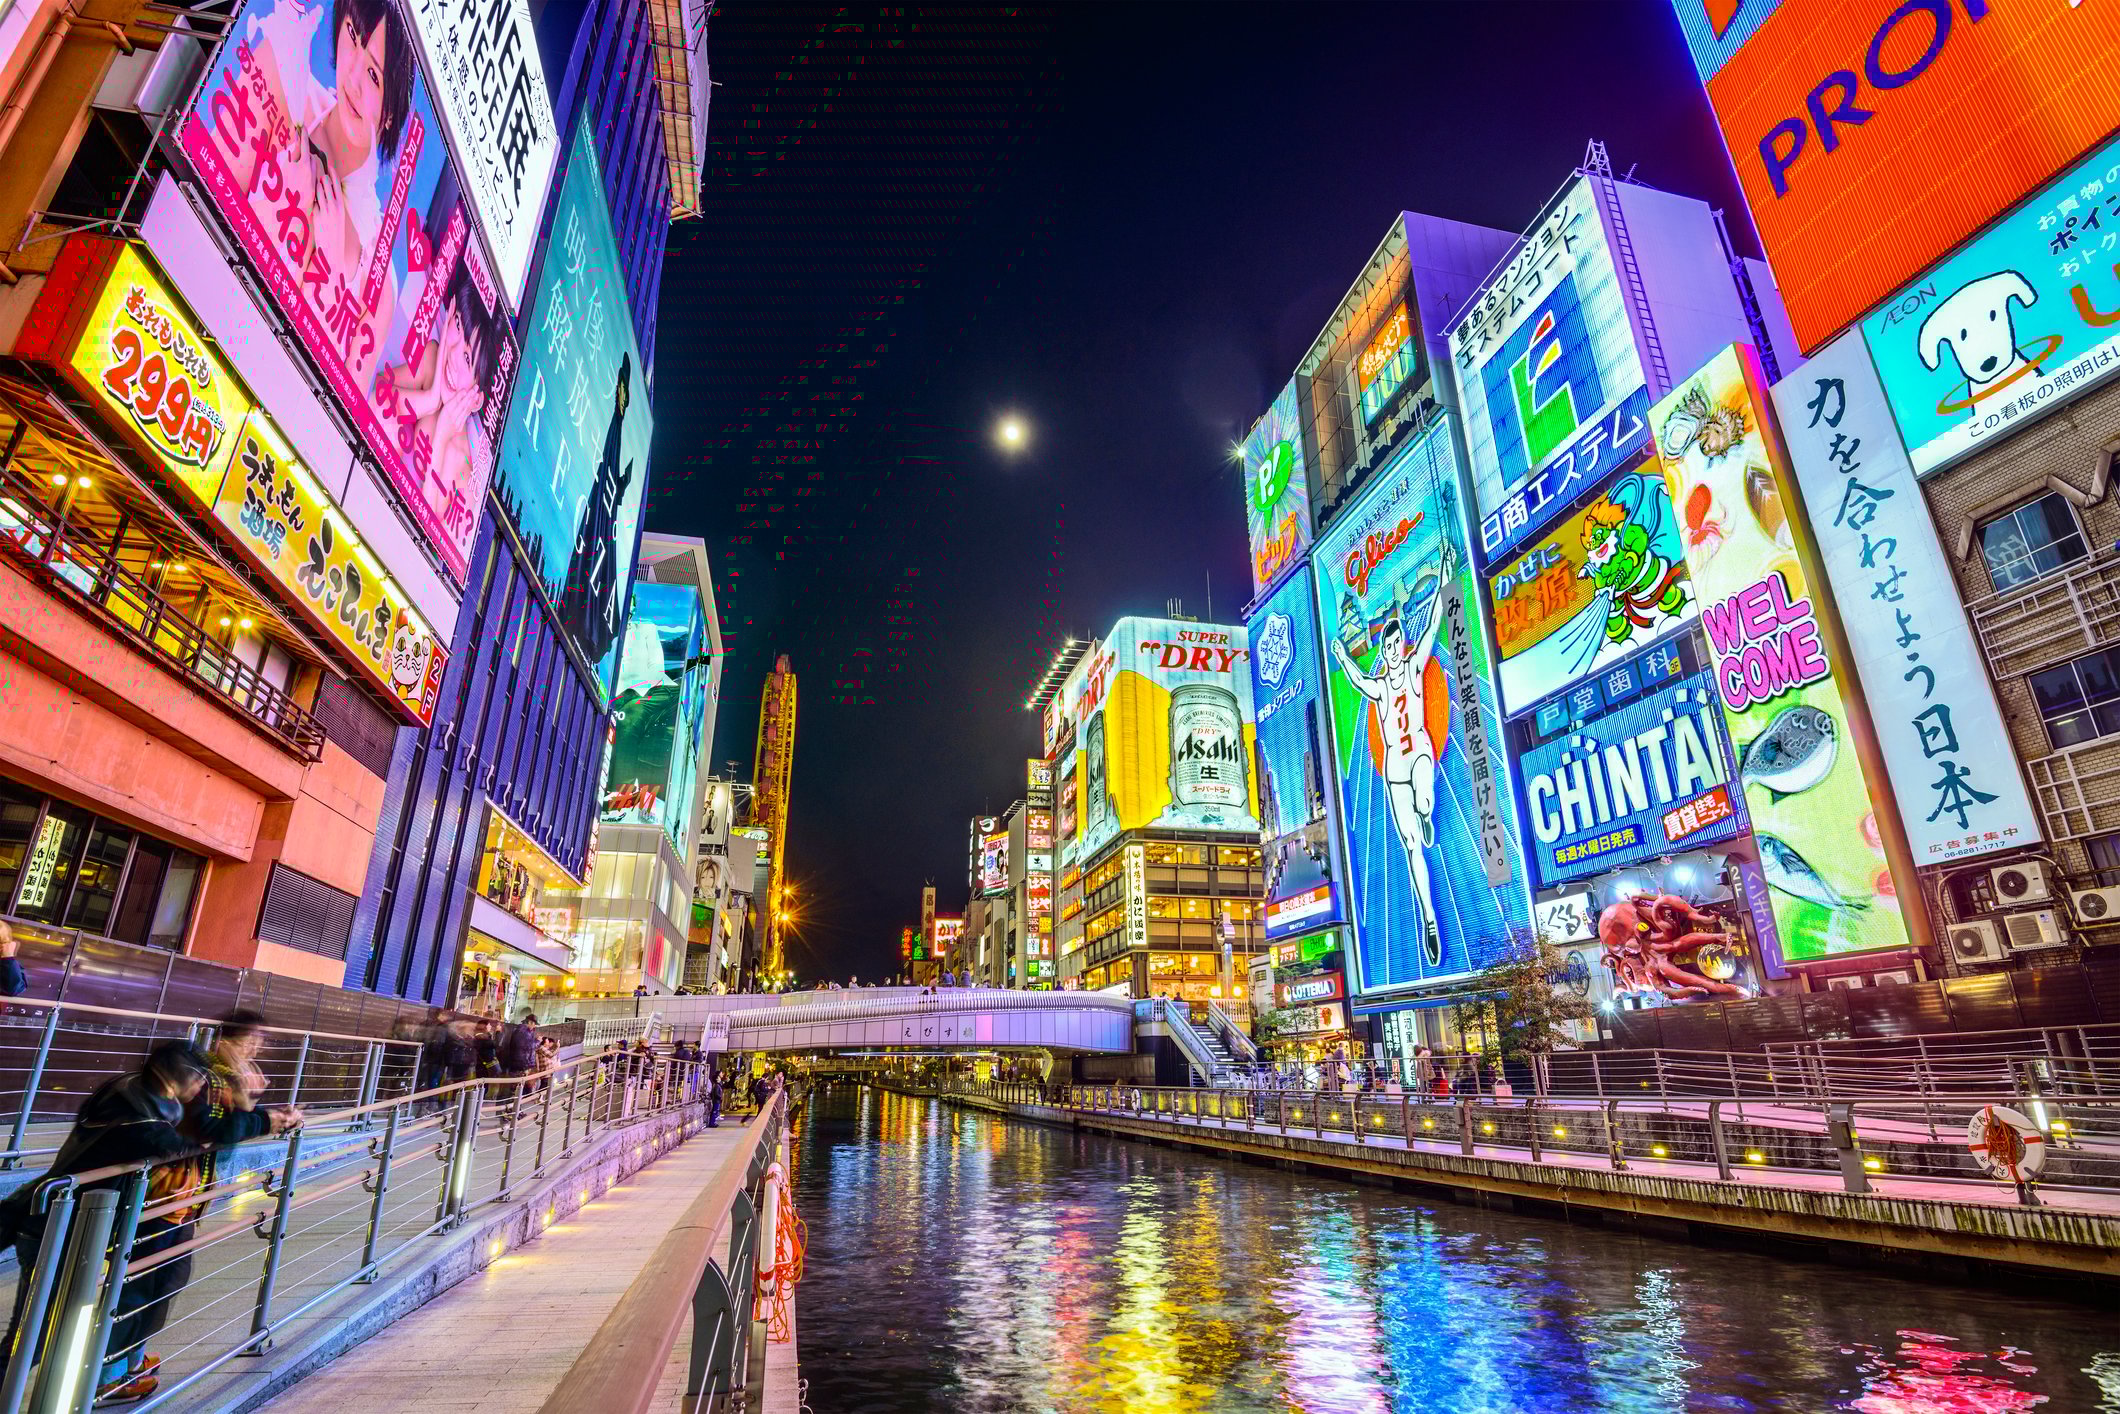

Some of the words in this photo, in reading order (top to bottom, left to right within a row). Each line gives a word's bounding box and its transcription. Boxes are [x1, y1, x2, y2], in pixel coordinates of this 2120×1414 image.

[1759, 0, 1990, 199] PRO
[410, 227, 424, 265] VS
[1456, 205, 1569, 345] 夢あるマンション
[465, 245, 494, 311] NMB48
[1462, 232, 1578, 369] エステムコート
[102, 326, 214, 467] 299円
[1481, 409, 1644, 552] 日商エステム
[1256, 512, 1298, 584] ピップ
[1494, 542, 1562, 600] かぜに
[1703, 574, 1810, 656] WEL
[1807, 378, 2000, 830] 力を合わせよう日本
[1177, 630, 1229, 645] SUPER
[1719, 624, 1828, 709] COME
[421, 656, 443, 714] 2F
[1178, 732, 1238, 763] Asahi
[1393, 690, 1413, 756] グリコ
[1447, 597, 1504, 867] みんなに笑顔を届けたい。
[1200, 765, 1219, 780] 生
[1664, 805, 1700, 841] 賃貸
[1695, 794, 1716, 812] 住宅
[1699, 801, 1730, 823] ニュース
[1555, 828, 1636, 864] 毎週水曜日発売
[1929, 828, 2018, 853] 広告募集中
[1944, 841, 2005, 858] 06-6281-1717
[1731, 866, 1742, 898] 2F
[1291, 981, 1330, 999] LOTTERIA
